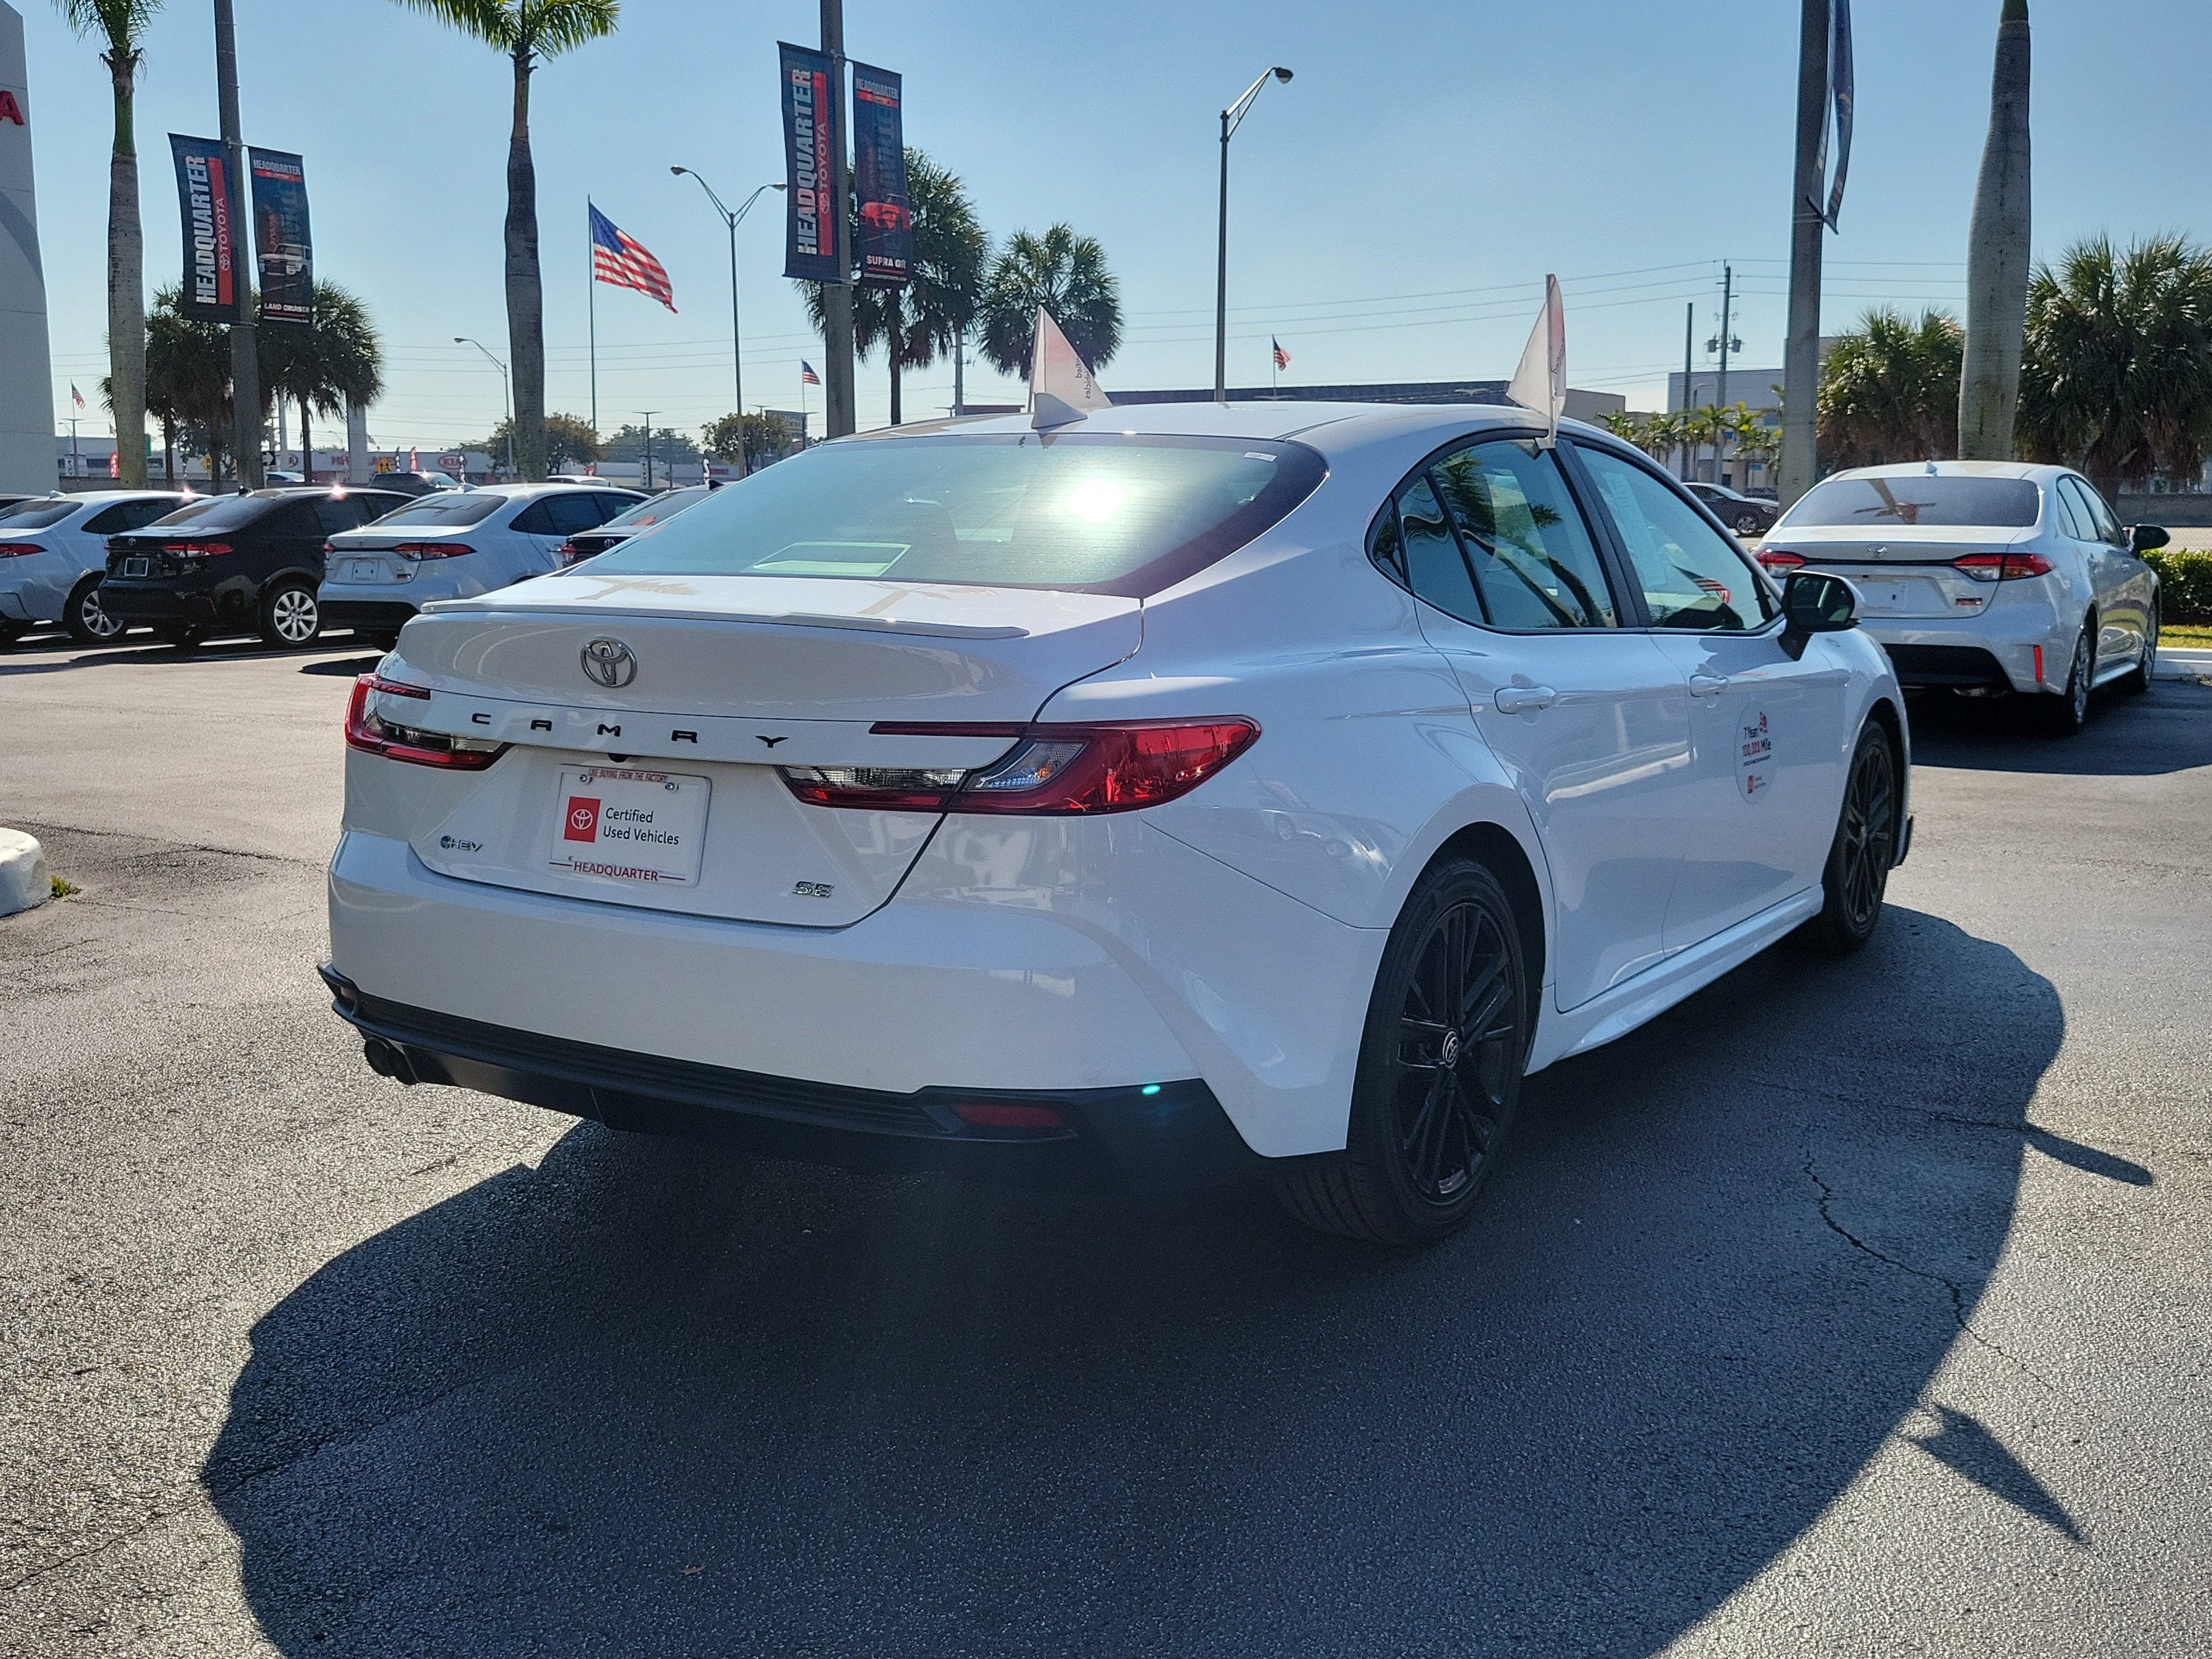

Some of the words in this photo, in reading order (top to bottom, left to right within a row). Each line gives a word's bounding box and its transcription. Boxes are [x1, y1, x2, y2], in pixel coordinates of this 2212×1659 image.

[855, 77, 899, 99] HEADQUARTER
[0, 91, 25, 125] A
[792, 68, 817, 256] HEADQUARTER
[817, 123, 828, 190] TOYOTA
[253, 159, 301, 176] HEADQUARTER
[185, 155, 217, 305] HEADQUARTER
[216, 198, 229, 252] TOYOTA
[866, 254, 894, 269] SUPRA
[895, 259, 907, 270] GR
[264, 303, 282, 311] LAND
[283, 305, 310, 314] CRUISER
[472, 712, 789, 748] CAMRY
[599, 769, 617, 779] BUYING
[618, 771, 633, 780] FROM
[635, 772, 644, 782] THE
[606, 807, 654, 823] Certified
[603, 826, 630, 840] Used
[634, 828, 680, 845] Vehicles
[574, 861, 658, 882] HEADQUARTER
[793, 881, 835, 898] SE
